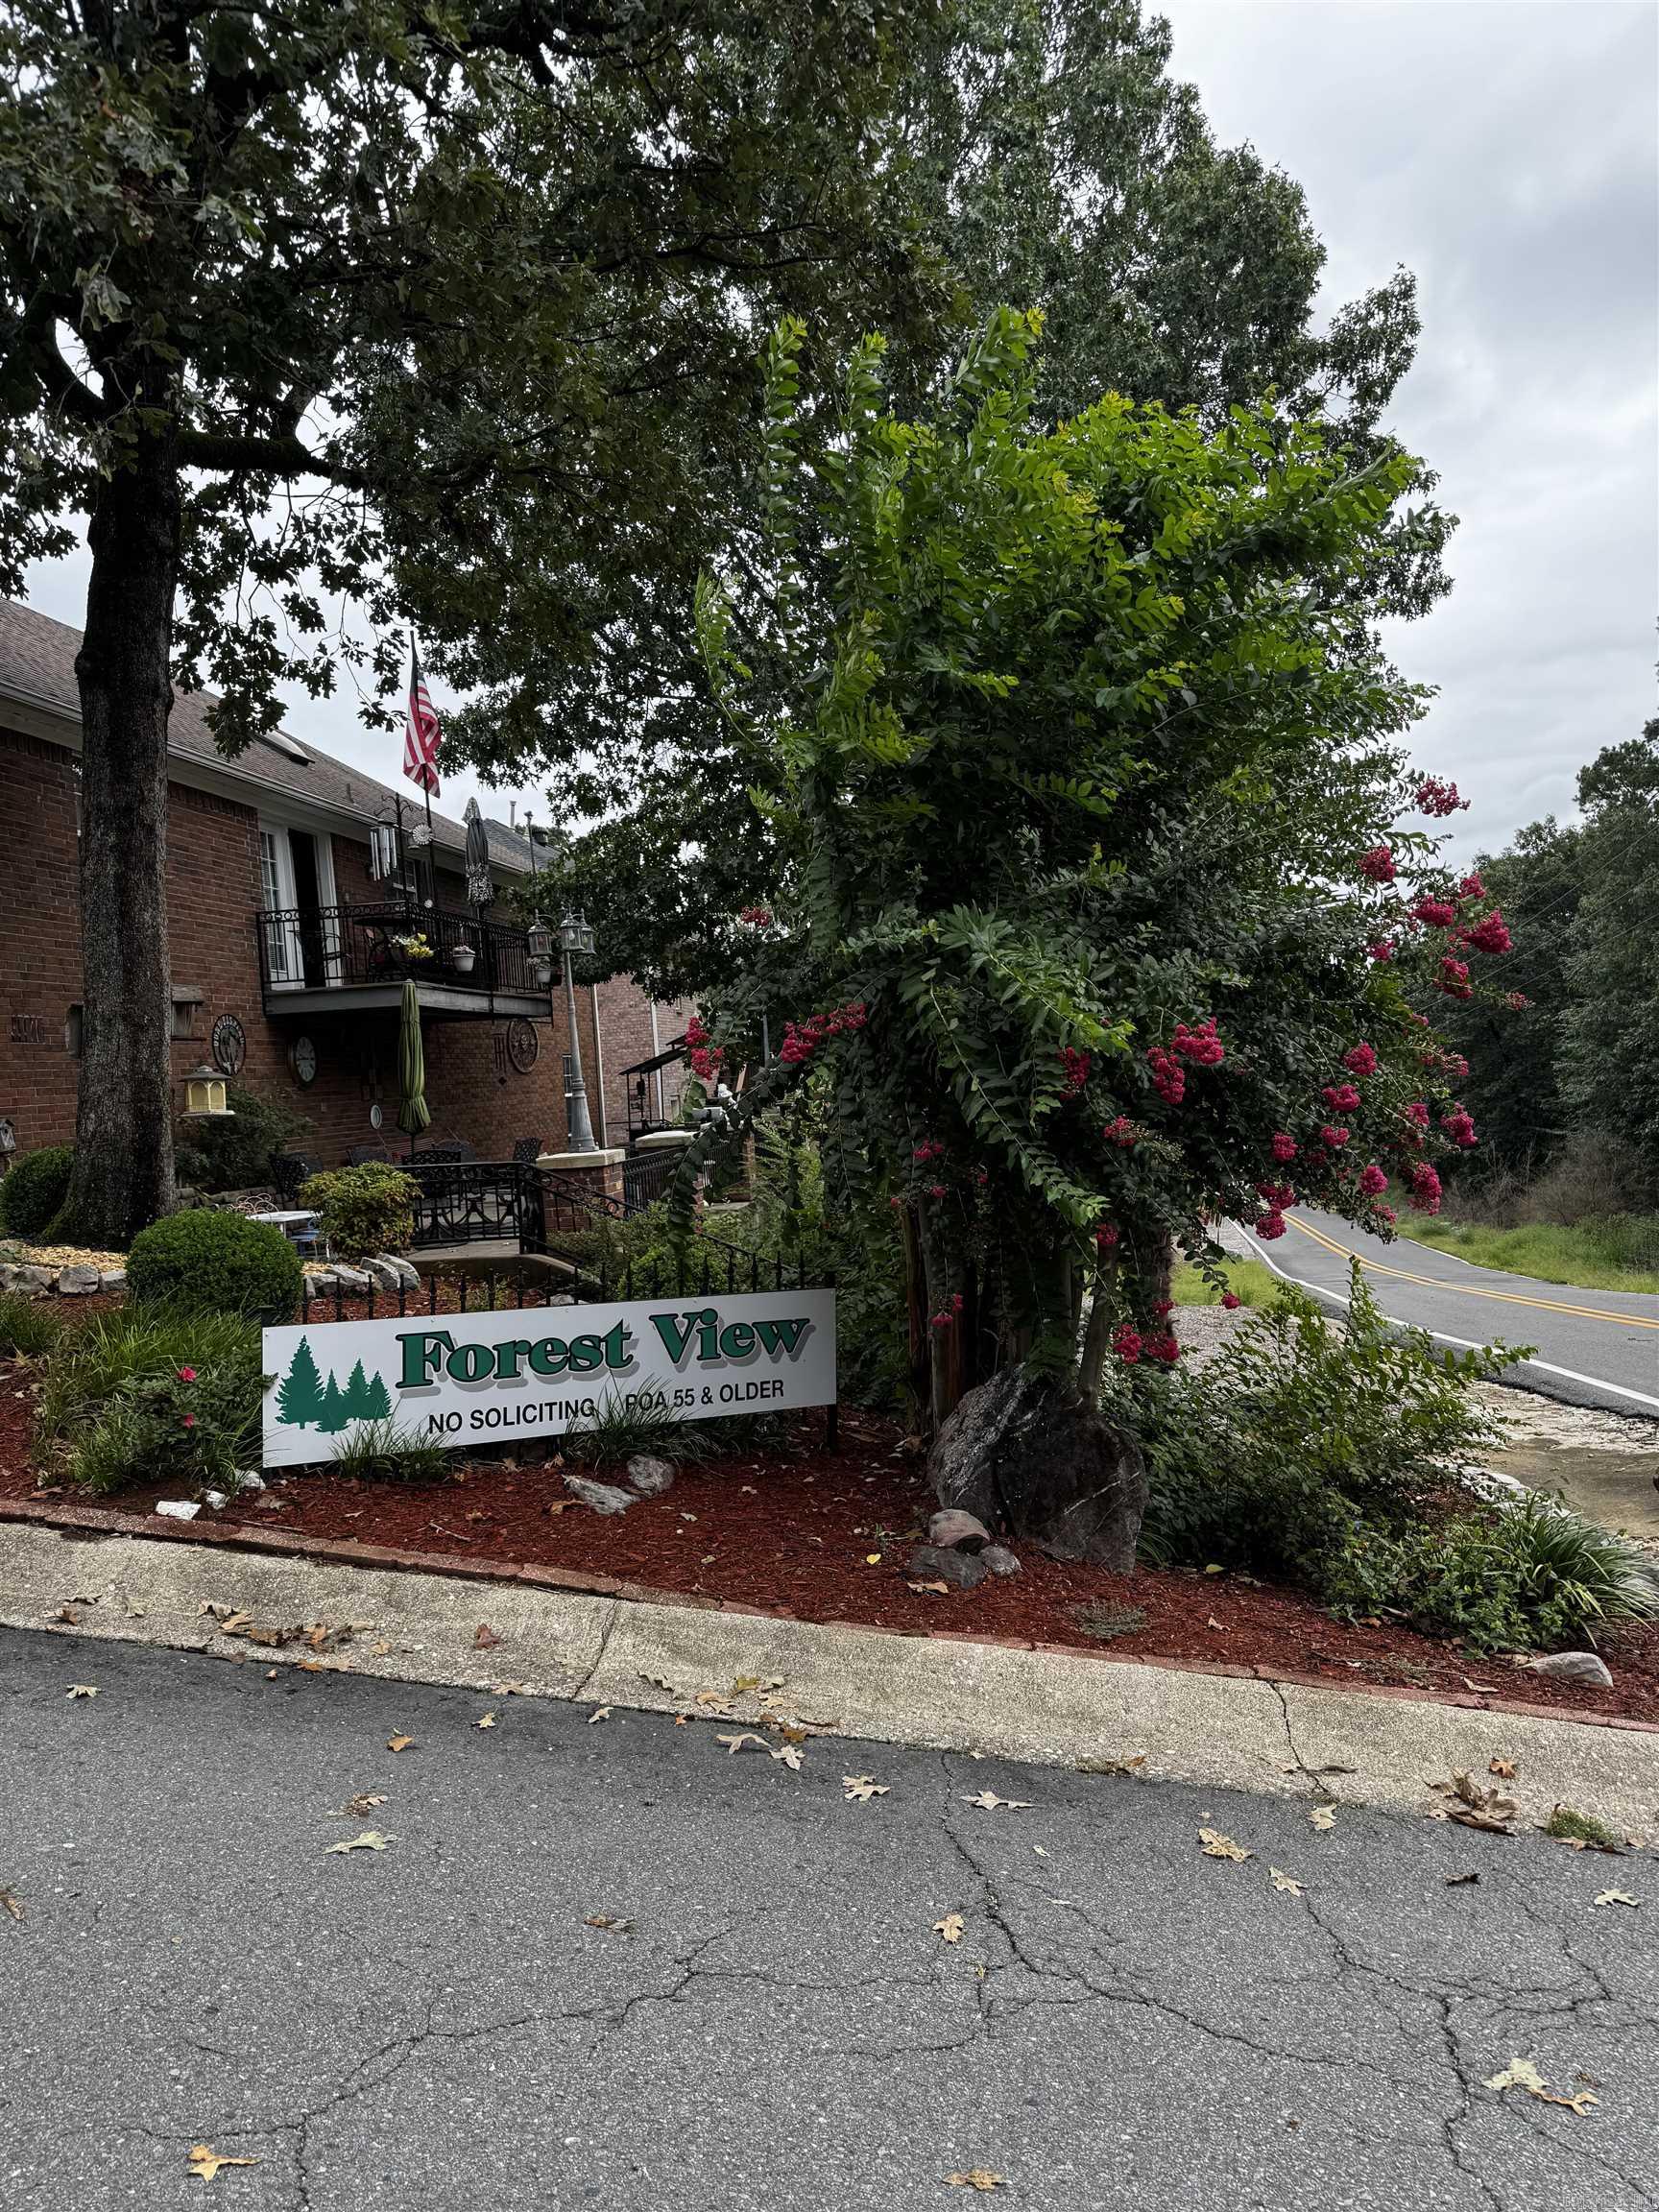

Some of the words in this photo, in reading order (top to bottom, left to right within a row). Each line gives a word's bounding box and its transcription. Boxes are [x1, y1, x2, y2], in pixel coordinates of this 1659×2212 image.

[395, 1318, 634, 1389] Forest
[649, 1308, 810, 1364] View
[428, 1411, 463, 1434] NO
[469, 1398, 595, 1431] SOLICITING
[673, 1388, 696, 1408] 55
[701, 1385, 714, 1405] &
[719, 1380, 785, 1403] OLDER
